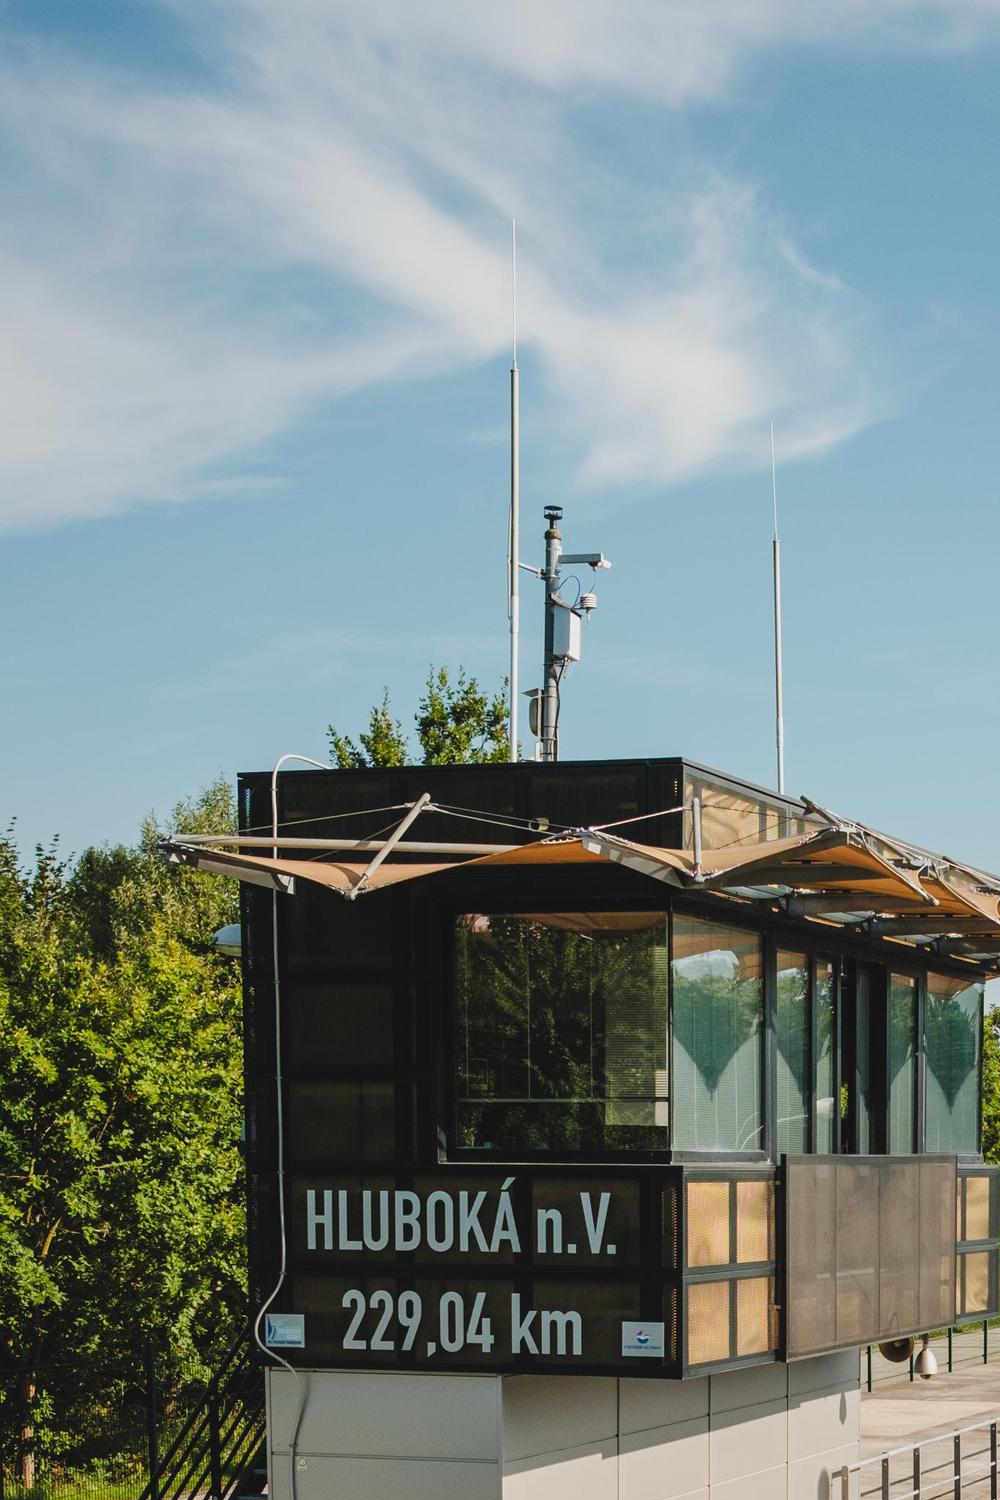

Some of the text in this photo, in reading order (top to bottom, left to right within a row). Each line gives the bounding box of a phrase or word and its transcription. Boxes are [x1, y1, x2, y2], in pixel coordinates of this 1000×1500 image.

[307, 1177, 521, 1252] HLUBOKÁ
[342, 1289, 582, 1357] 229,04 km
